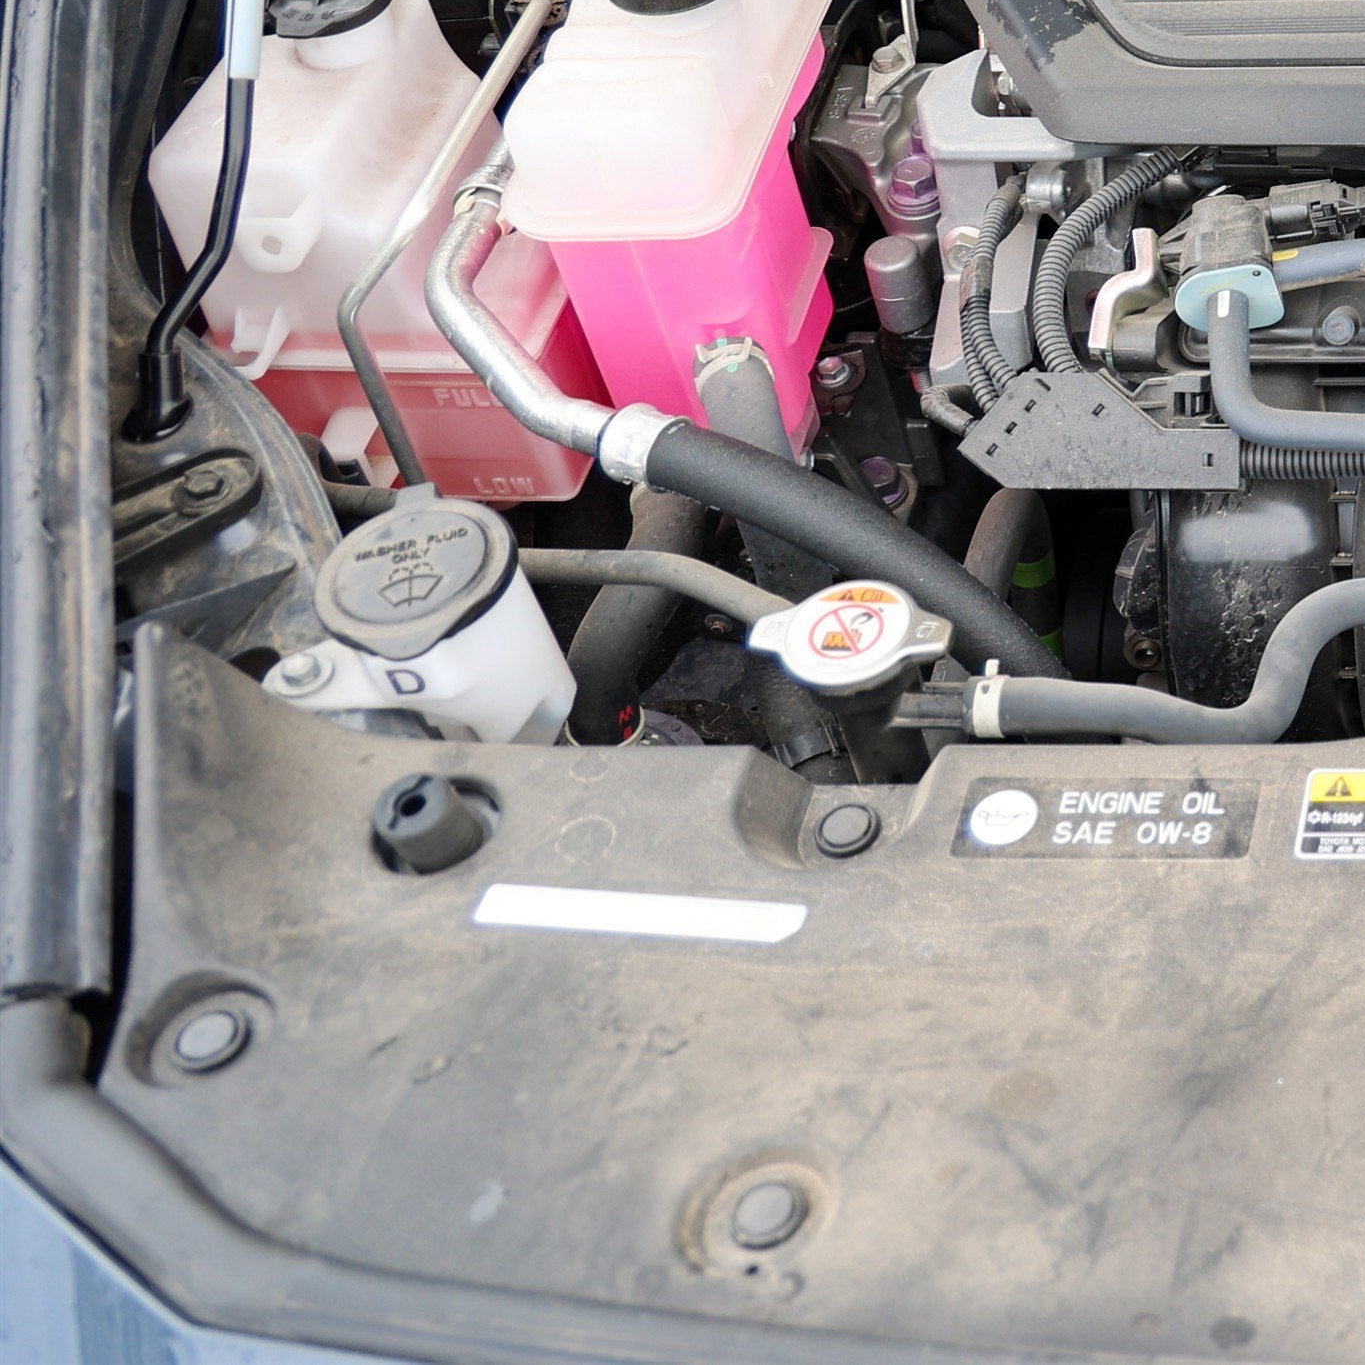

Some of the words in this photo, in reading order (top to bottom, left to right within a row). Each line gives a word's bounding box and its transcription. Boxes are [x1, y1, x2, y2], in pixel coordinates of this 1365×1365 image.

[473, 477, 536, 495] LOW
[355, 539, 417, 563] WASHER
[427, 527, 469, 545] FLUID
[392, 547, 430, 564] ONLY
[384, 668, 427, 696] D
[1058, 790, 1165, 815] ENGINE
[1181, 791, 1227, 815] OIL
[1321, 810, 1363, 827] R-1234yf
[1051, 819, 1118, 845] SAE
[1319, 837, 1351, 846] TOYOTA
